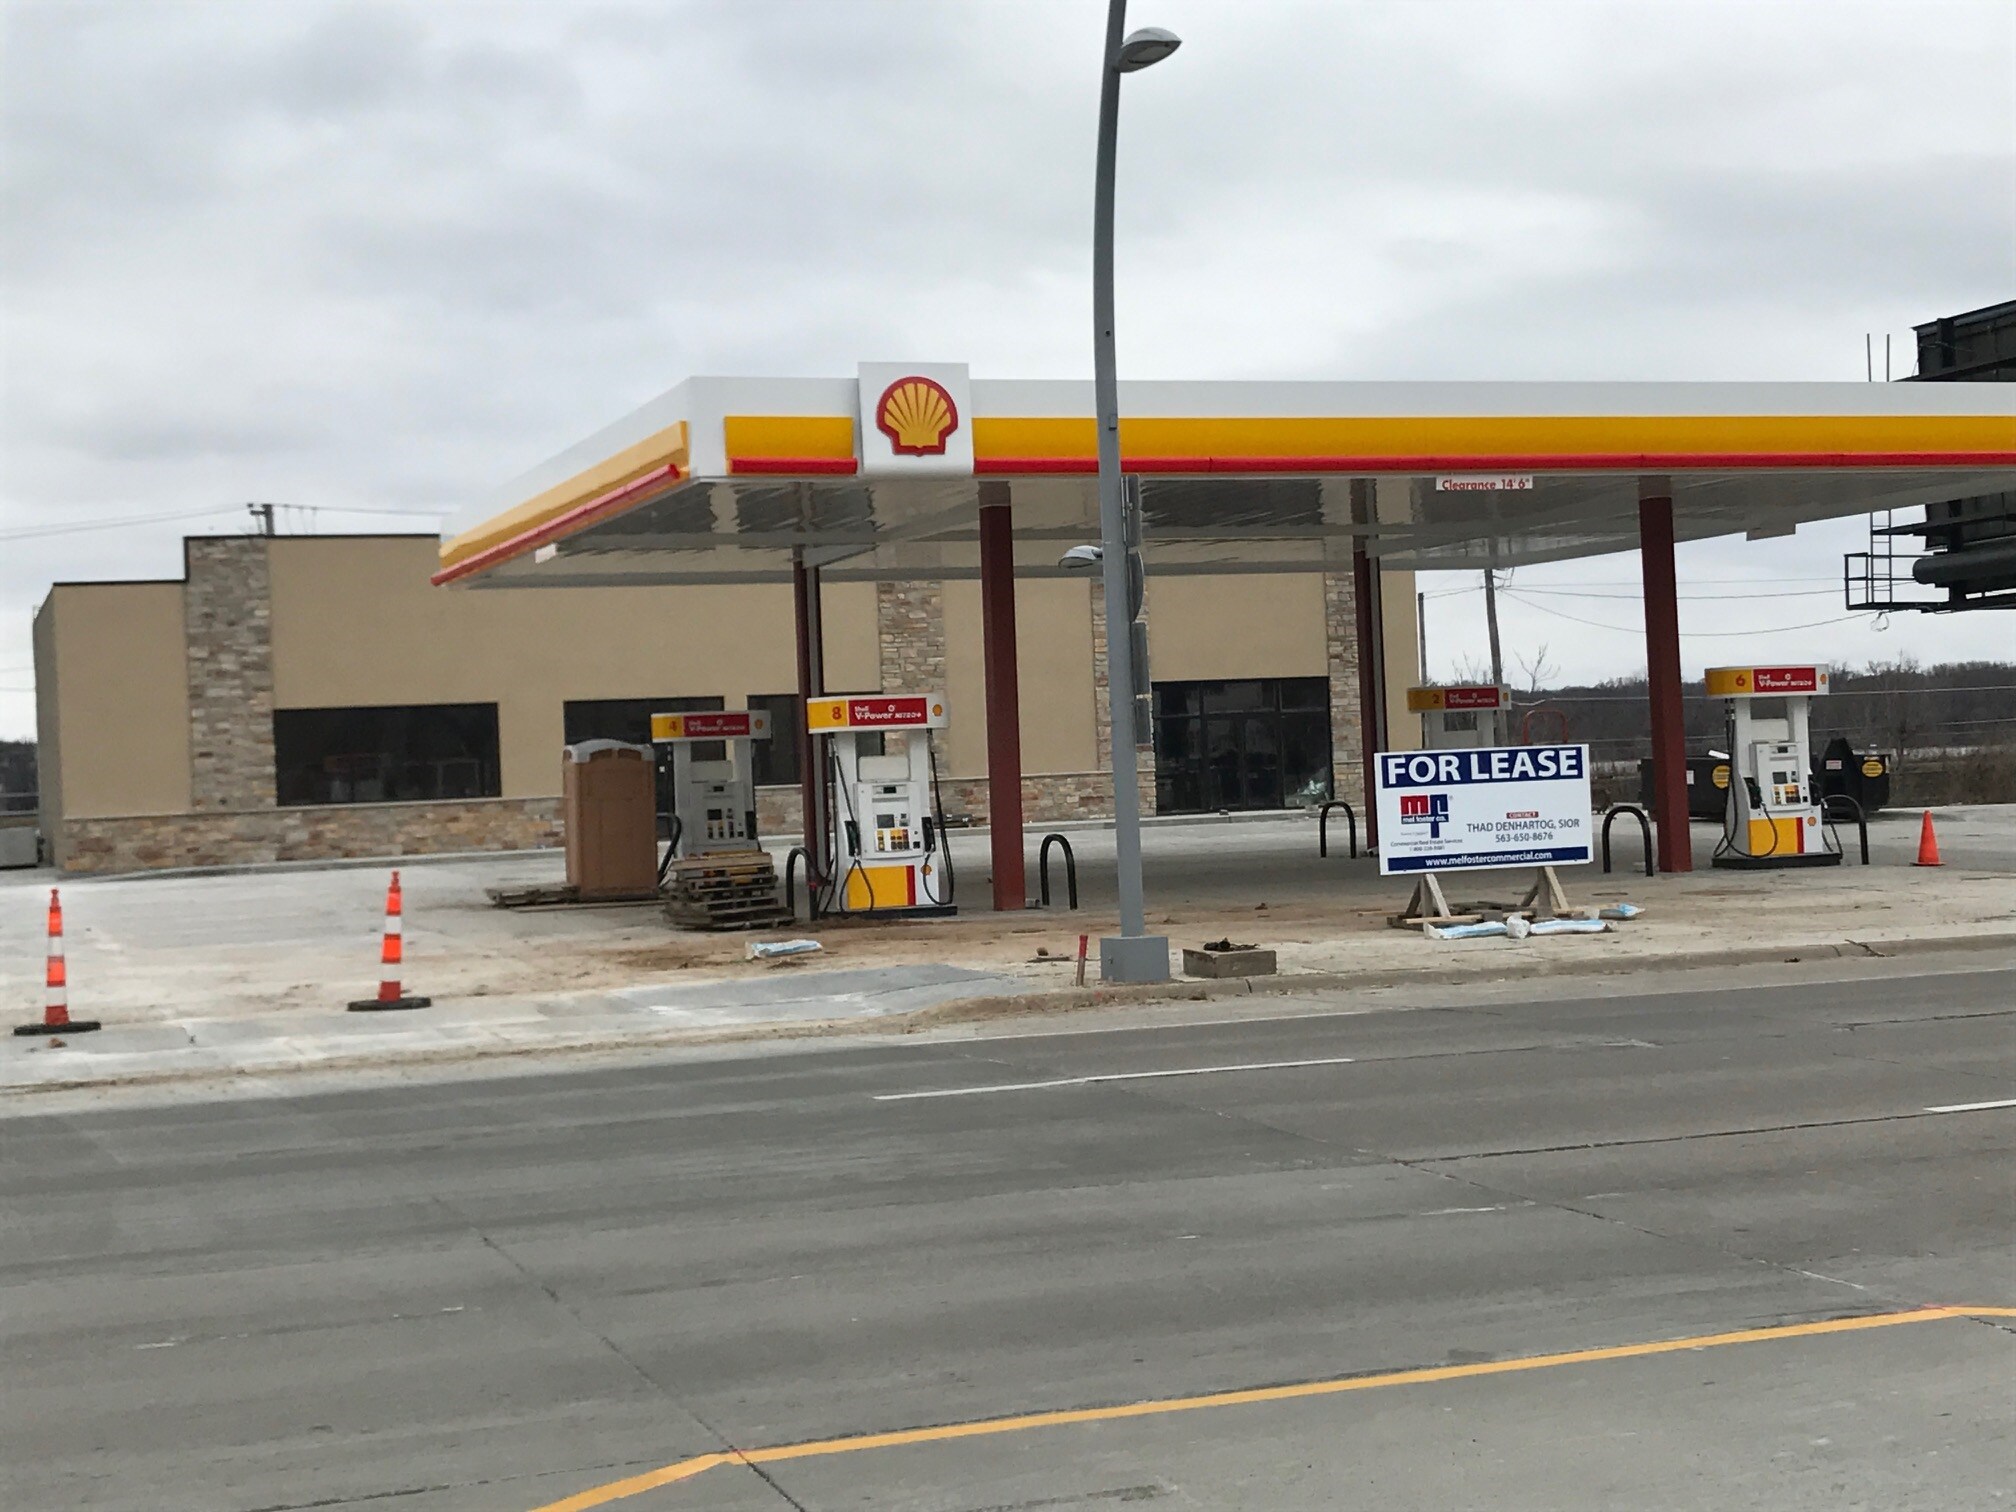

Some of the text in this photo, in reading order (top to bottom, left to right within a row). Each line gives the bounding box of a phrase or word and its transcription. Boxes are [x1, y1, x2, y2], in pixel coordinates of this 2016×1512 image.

[1442, 479, 1496, 491] Clearance
[1735, 674, 1746, 687] 6
[1758, 680, 1789, 688] V-Power
[1431, 693, 1440, 704] 2
[832, 706, 842, 720] 8
[855, 711, 892, 720] V-Power
[669, 720, 678, 732] 4
[1387, 750, 1578, 785] FOR LEASE
[1466, 818, 1580, 832] THAD DENHARTOG, SIOR
[1495, 832, 1554, 843] 563-650-8676
[1425, 851, 1553, 867] www.melfostercommercial.com
